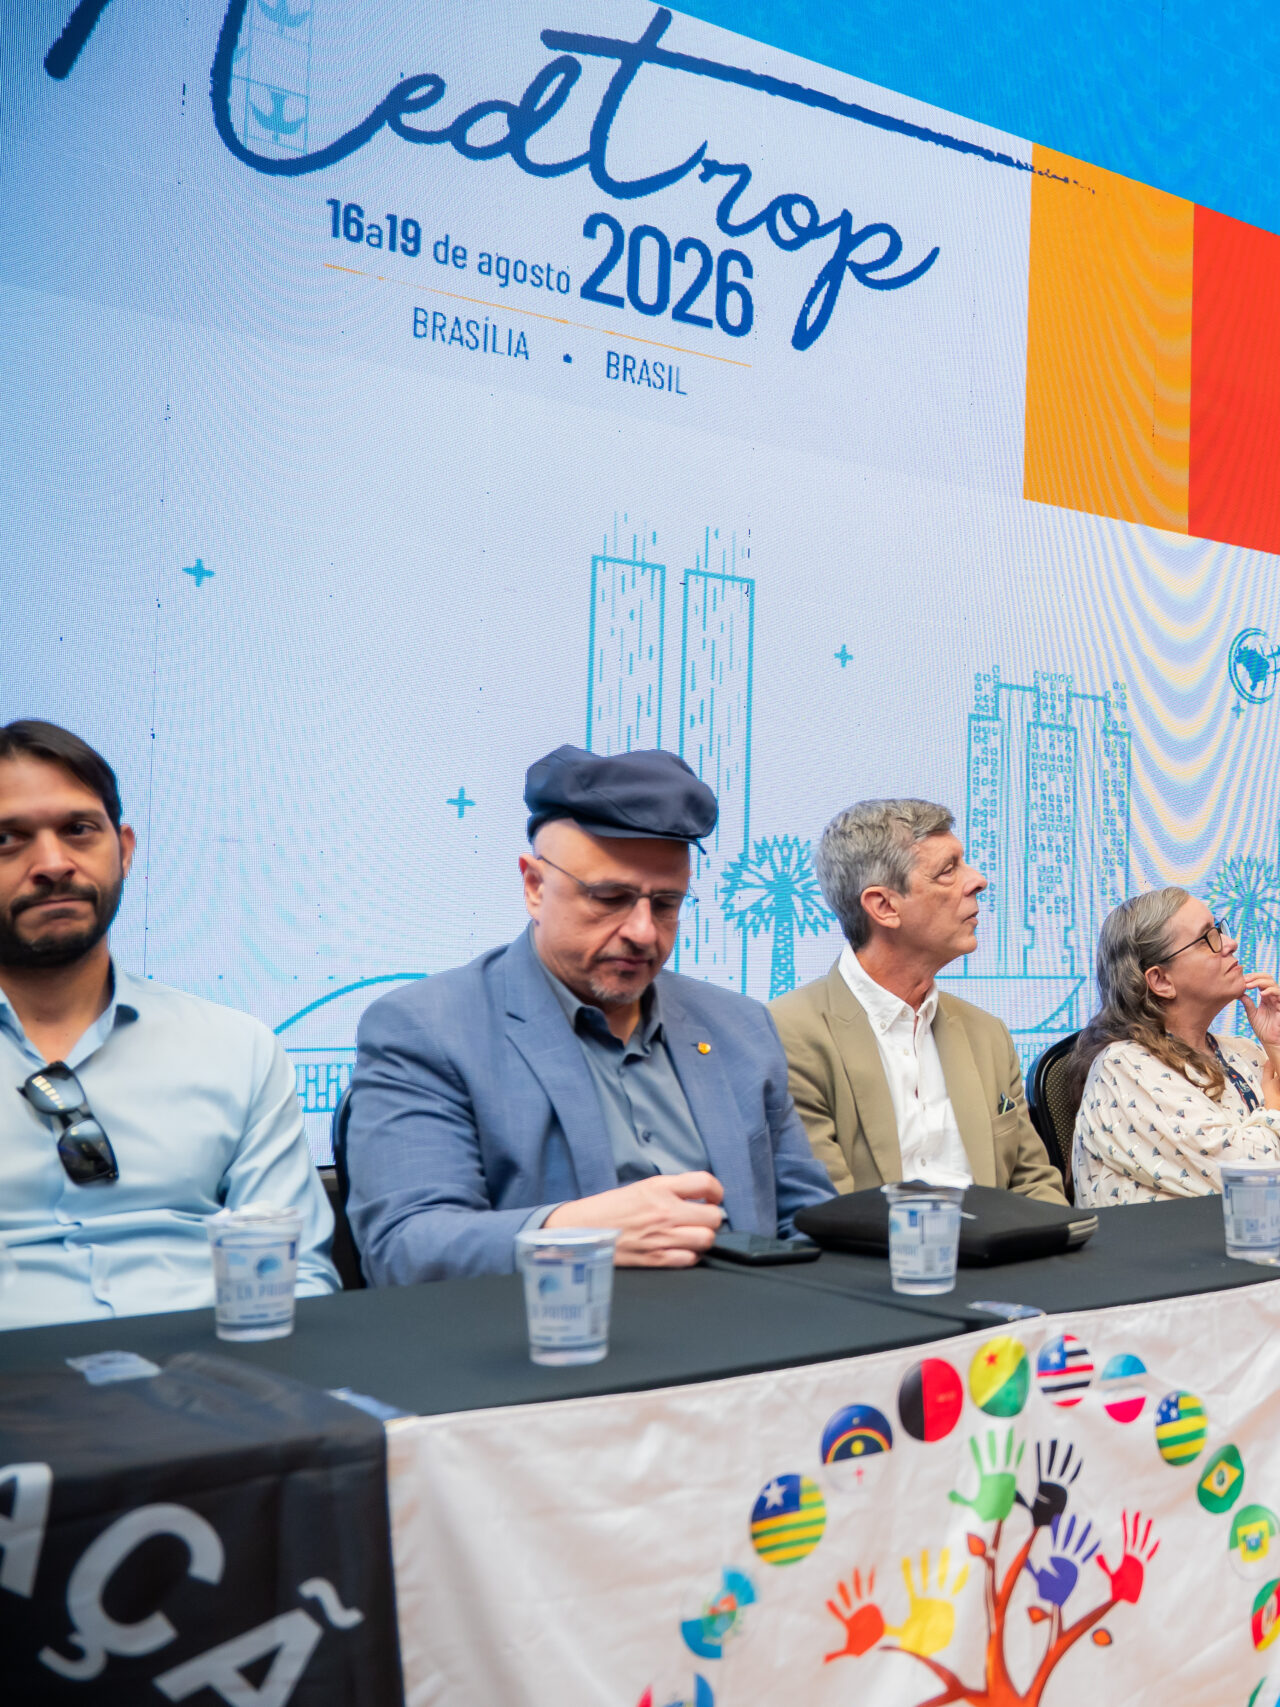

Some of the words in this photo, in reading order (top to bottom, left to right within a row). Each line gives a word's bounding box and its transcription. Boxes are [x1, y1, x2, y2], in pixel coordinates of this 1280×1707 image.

[432, 235, 469, 271] de
[477, 247, 571, 296] agosto
[579, 212, 754, 338] 2026
[411, 306, 530, 361] BRASÍLIA
[606, 351, 688, 397] BRASIL
